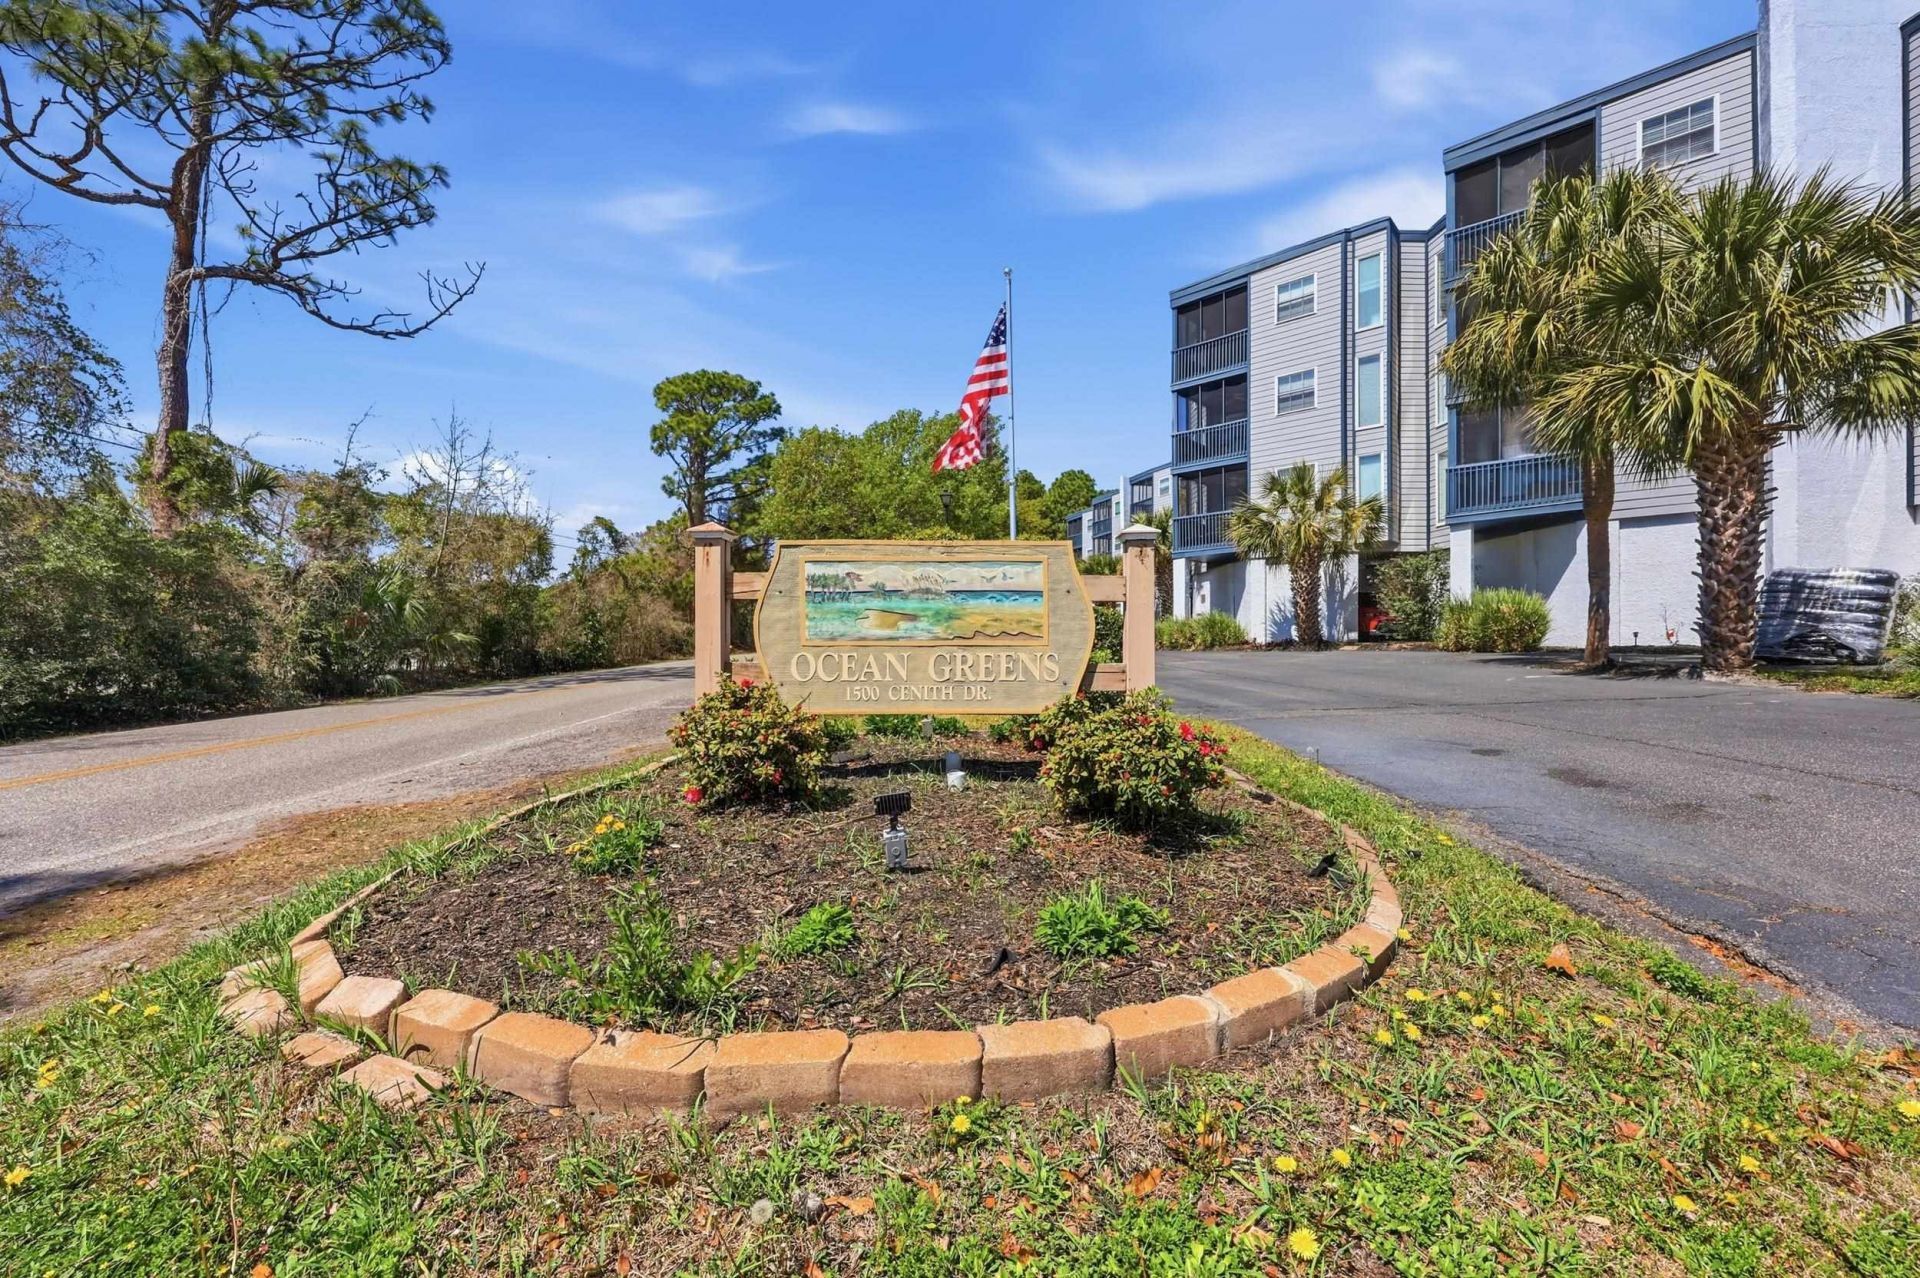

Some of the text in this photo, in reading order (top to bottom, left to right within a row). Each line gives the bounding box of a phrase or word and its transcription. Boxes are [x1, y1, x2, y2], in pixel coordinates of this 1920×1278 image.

[791, 651, 1060, 682] OCEAN GREENS
[846, 686, 992, 701] 1500 CENITH DR.
